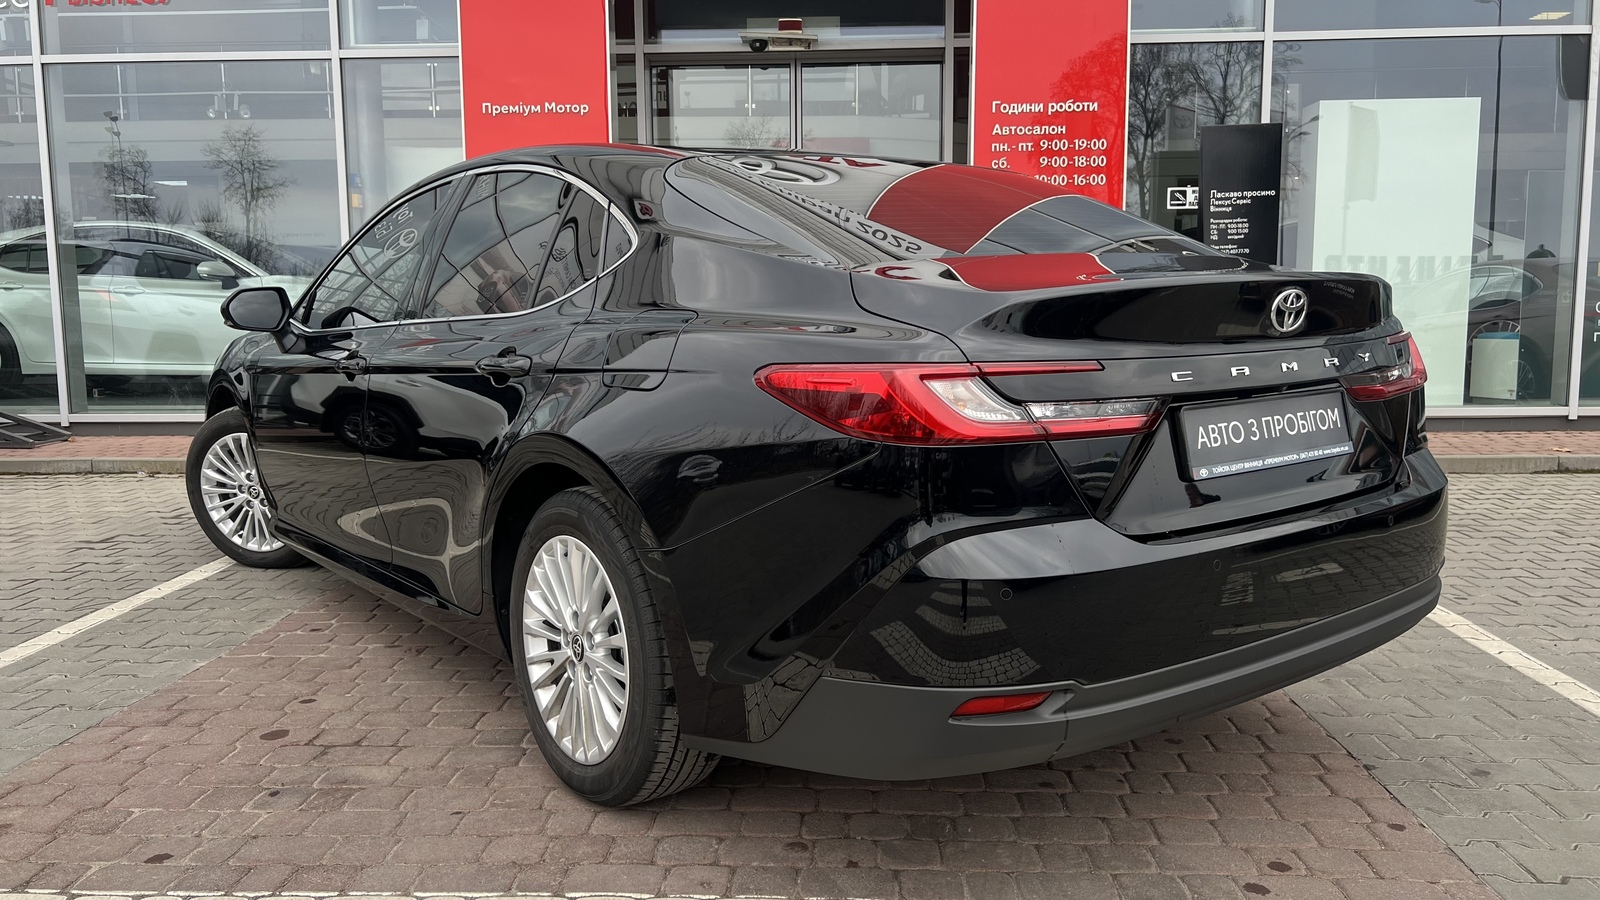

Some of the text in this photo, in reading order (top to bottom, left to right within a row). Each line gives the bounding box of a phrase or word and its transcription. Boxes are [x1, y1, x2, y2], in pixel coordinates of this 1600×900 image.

[482, 102, 589, 117] Преміум Мотор
[992, 99, 1098, 115] Години роботи
[992, 124, 1066, 135] Автосалон
[1040, 138, 1107, 151] 9:00-19:00
[991, 155, 1107, 169] сб. 9:00-18:00
[1210, 190, 1276, 199] Ласкаво просимо
[1210, 197, 1252, 206] Лексус Сервіс
[1171, 352, 1370, 382] CAMRY
[1197, 407, 1341, 449] АВТО З ПРОБІГОМ
